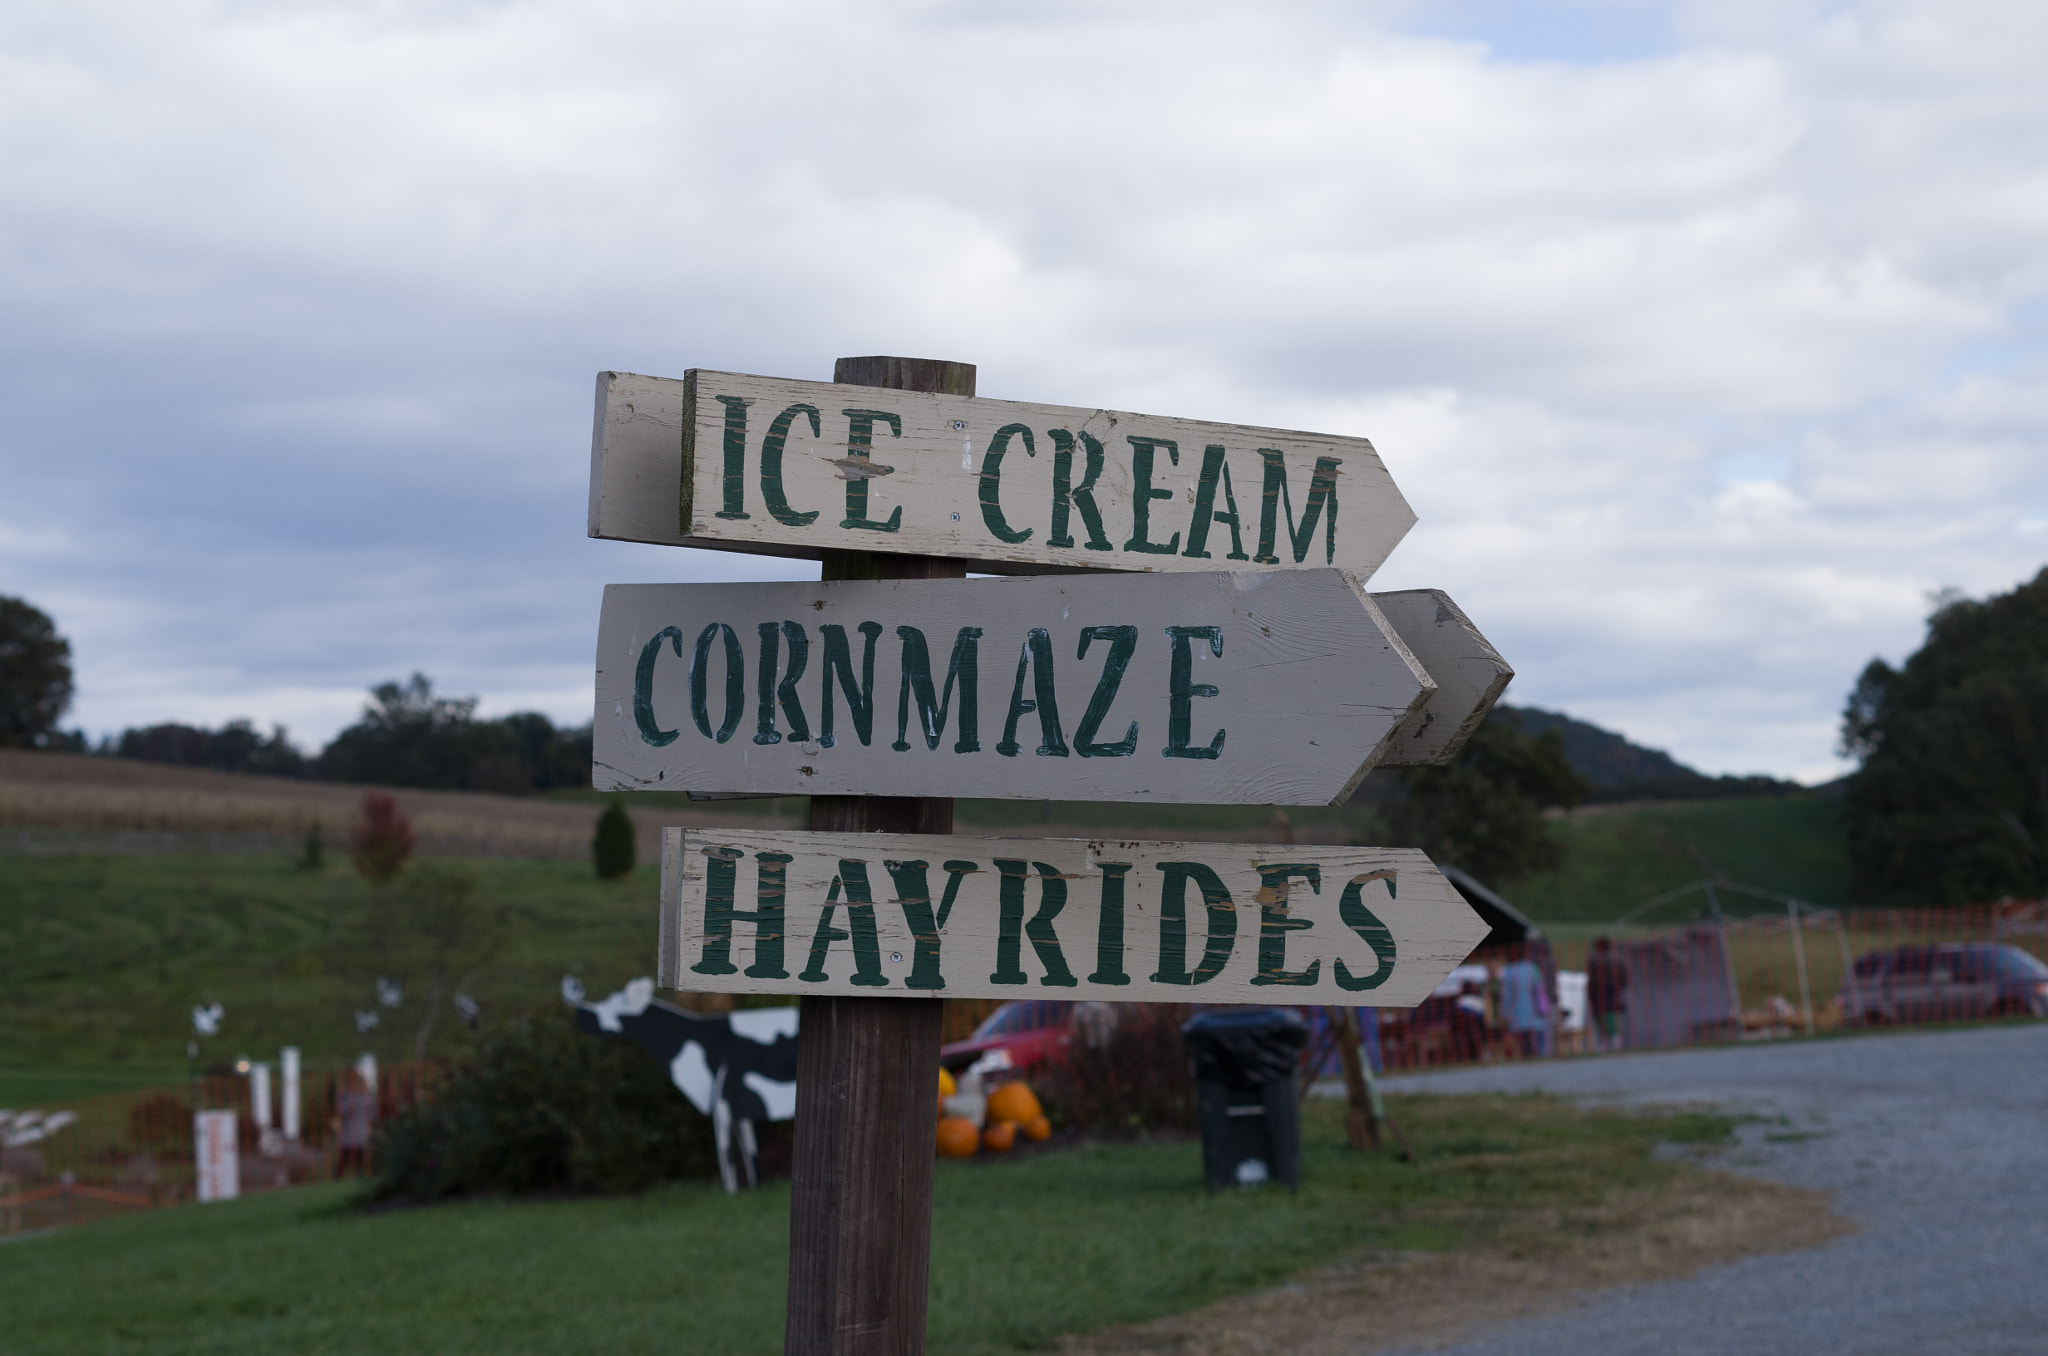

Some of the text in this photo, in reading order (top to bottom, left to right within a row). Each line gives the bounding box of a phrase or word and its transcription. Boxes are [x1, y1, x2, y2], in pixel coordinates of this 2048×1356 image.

[714, 394, 1344, 566] ICE CREAM
[632, 619, 1227, 761] CORNMAZE
[690, 846, 1398, 992] HAYRIDES
